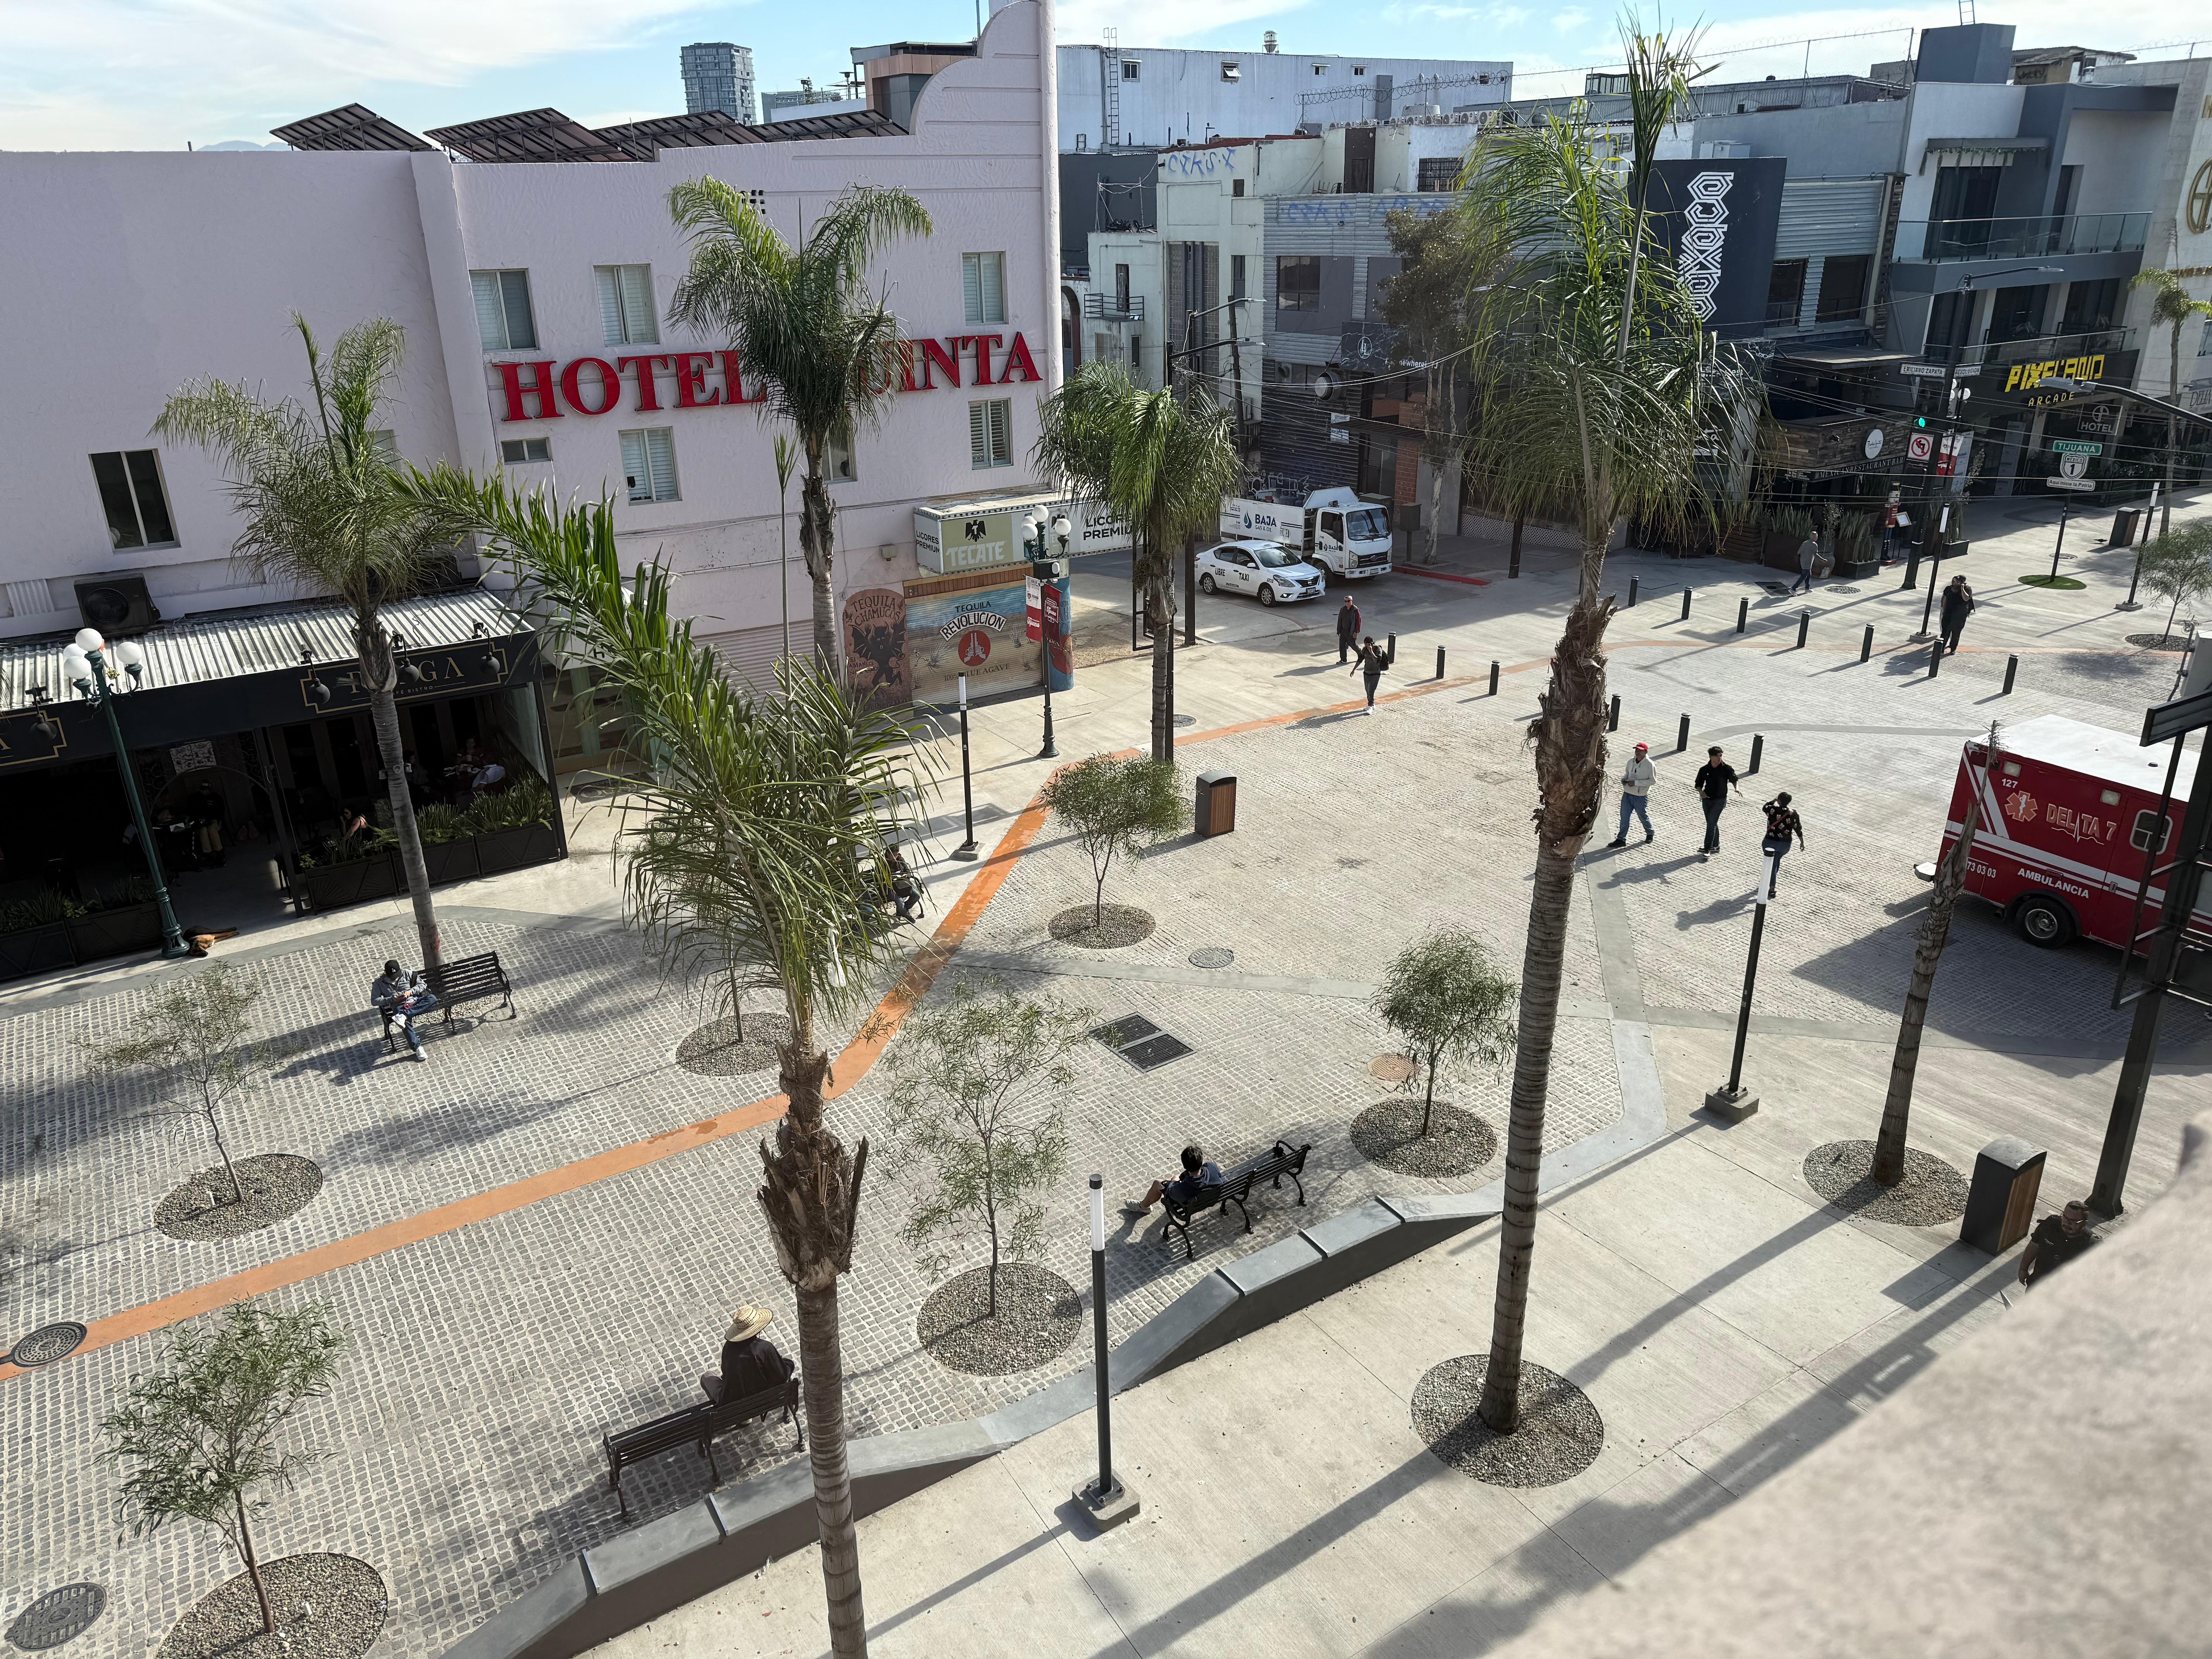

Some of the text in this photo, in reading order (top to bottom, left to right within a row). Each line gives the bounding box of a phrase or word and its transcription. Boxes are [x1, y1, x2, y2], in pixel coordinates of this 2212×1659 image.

[492, 350, 766, 422] HOTEL
[2028, 392, 2075, 407] ARCADE
[2081, 422, 2113, 433] HOTEL
[2058, 443, 2096, 453] TIJUANA
[2070, 464, 2075, 475] 1
[1255, 514, 1277, 527] BAJA
[916, 530, 939, 545] LICORES
[946, 541, 1006, 567] TECATE
[1215, 568, 1225, 576] LIBRE
[1239, 572, 1249, 581] TAXI
[851, 595, 895, 612] TEQUILA
[955, 601, 991, 613] TEQUILA
[855, 607, 901, 626] CHAMUCOS
[941, 612, 1004, 639] REVOLUCION
[983, 663, 1010, 674] AGAVE
[2001, 778, 2018, 789] 127
[2047, 803, 2117, 841] DELTA 7
[1977, 864, 1985, 875] 03
[1987, 867, 1996, 878] 03
[2018, 868, 2089, 899] AMBULANCIA
